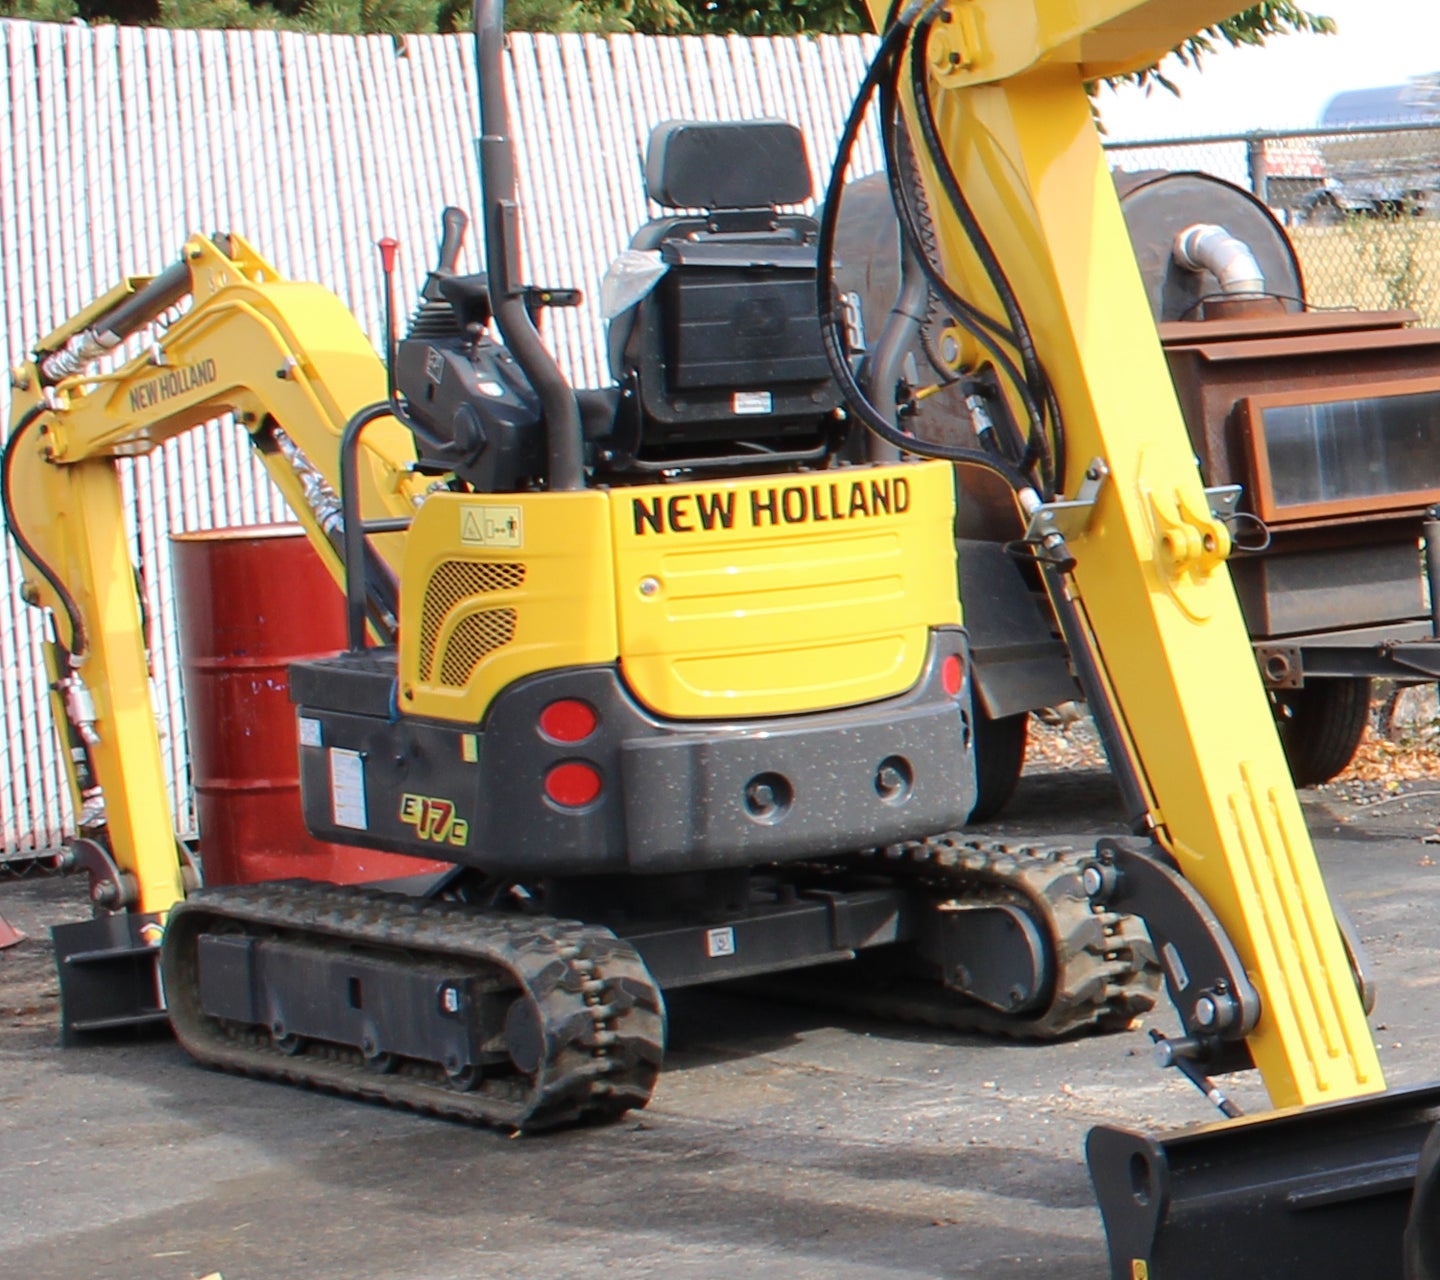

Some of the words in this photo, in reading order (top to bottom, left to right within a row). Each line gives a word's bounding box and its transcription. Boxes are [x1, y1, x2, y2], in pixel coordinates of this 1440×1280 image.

[129, 379, 159, 413] NEW
[160, 358, 217, 400] HOLLAND
[632, 491, 736, 536] NEW
[749, 477, 911, 527] HOLLAND
